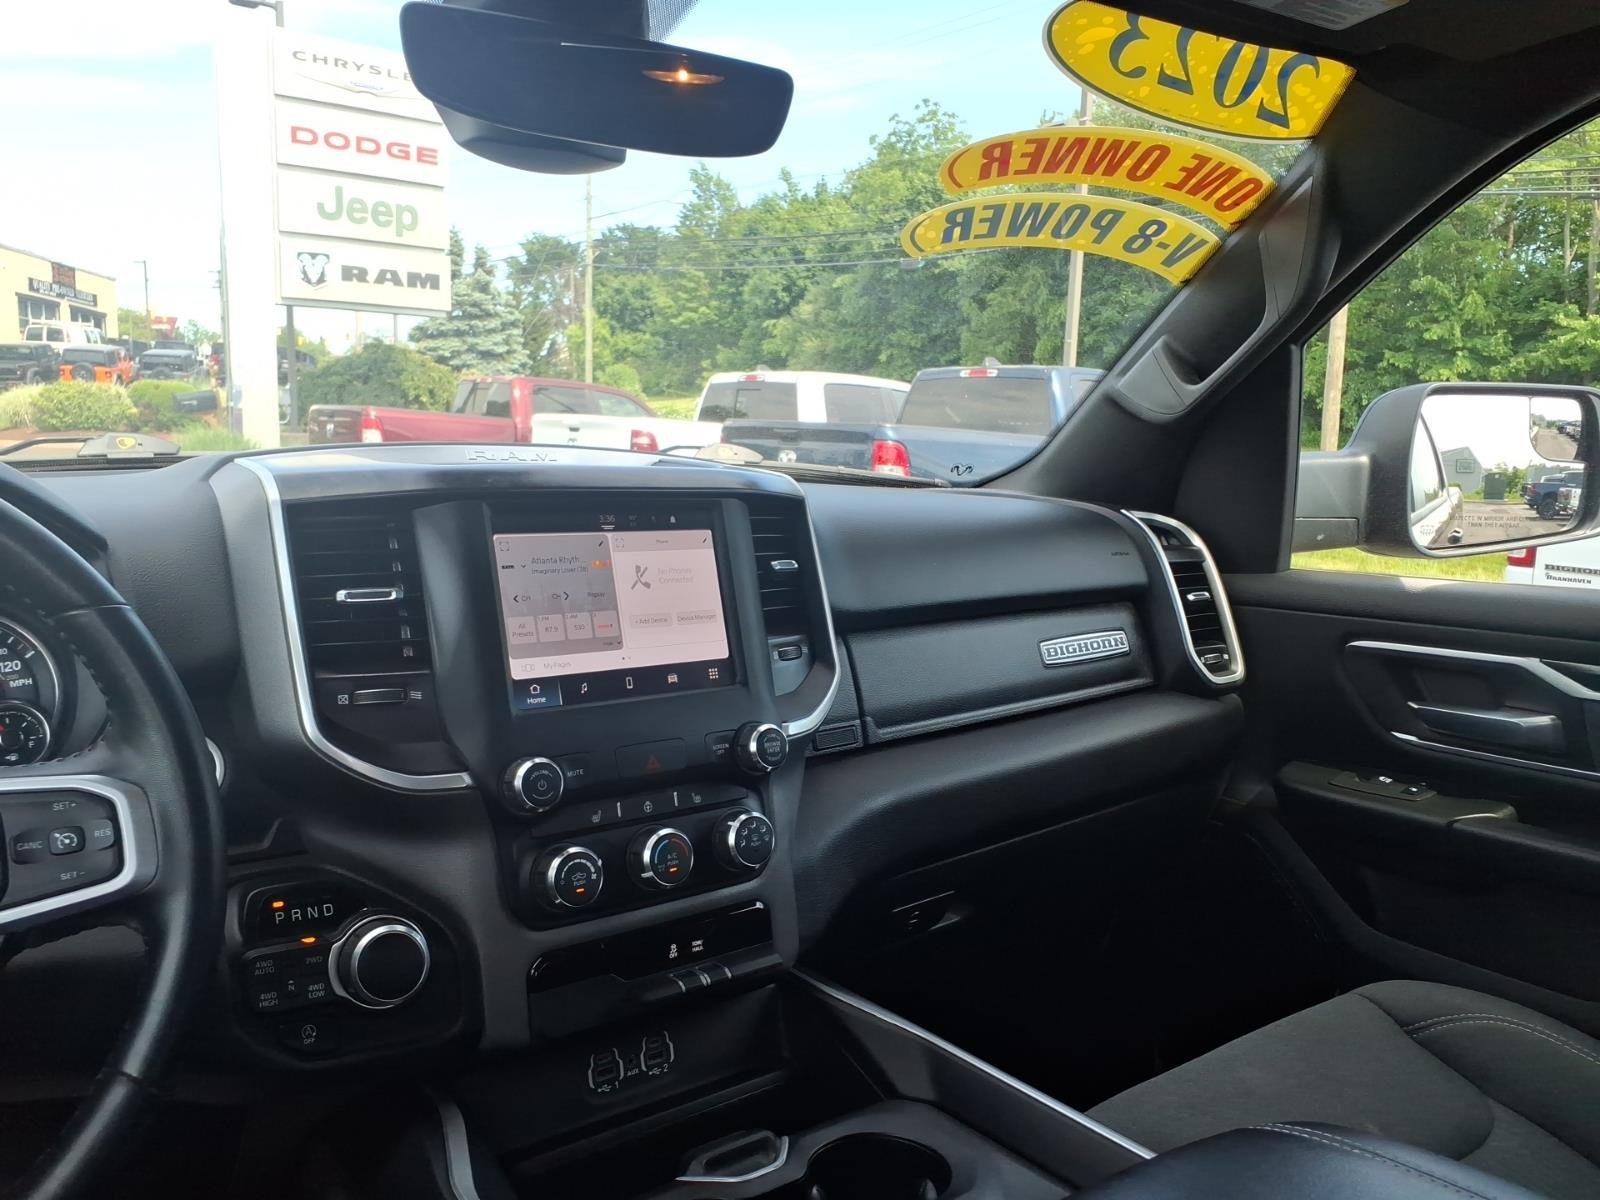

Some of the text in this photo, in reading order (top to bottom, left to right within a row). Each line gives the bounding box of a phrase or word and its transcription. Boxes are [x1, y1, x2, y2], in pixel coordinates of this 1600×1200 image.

[292, 50, 412, 82] CHRYSLE
[290, 125, 439, 166] DODGE
[316, 185, 419, 238] Jeep
[341, 264, 441, 291] RAM
[1044, 635, 1127, 659] BIGHORN
[9, 677, 33, 688] MPH
[527, 696, 547, 704] Home
[567, 768, 584, 777] MUTE
[94, 828, 112, 838] RES
[254, 966, 275, 976] AUTO
[259, 991, 277, 1001] 4WD
[308, 989, 325, 999] LOW
[259, 998, 279, 1008] HIGH
